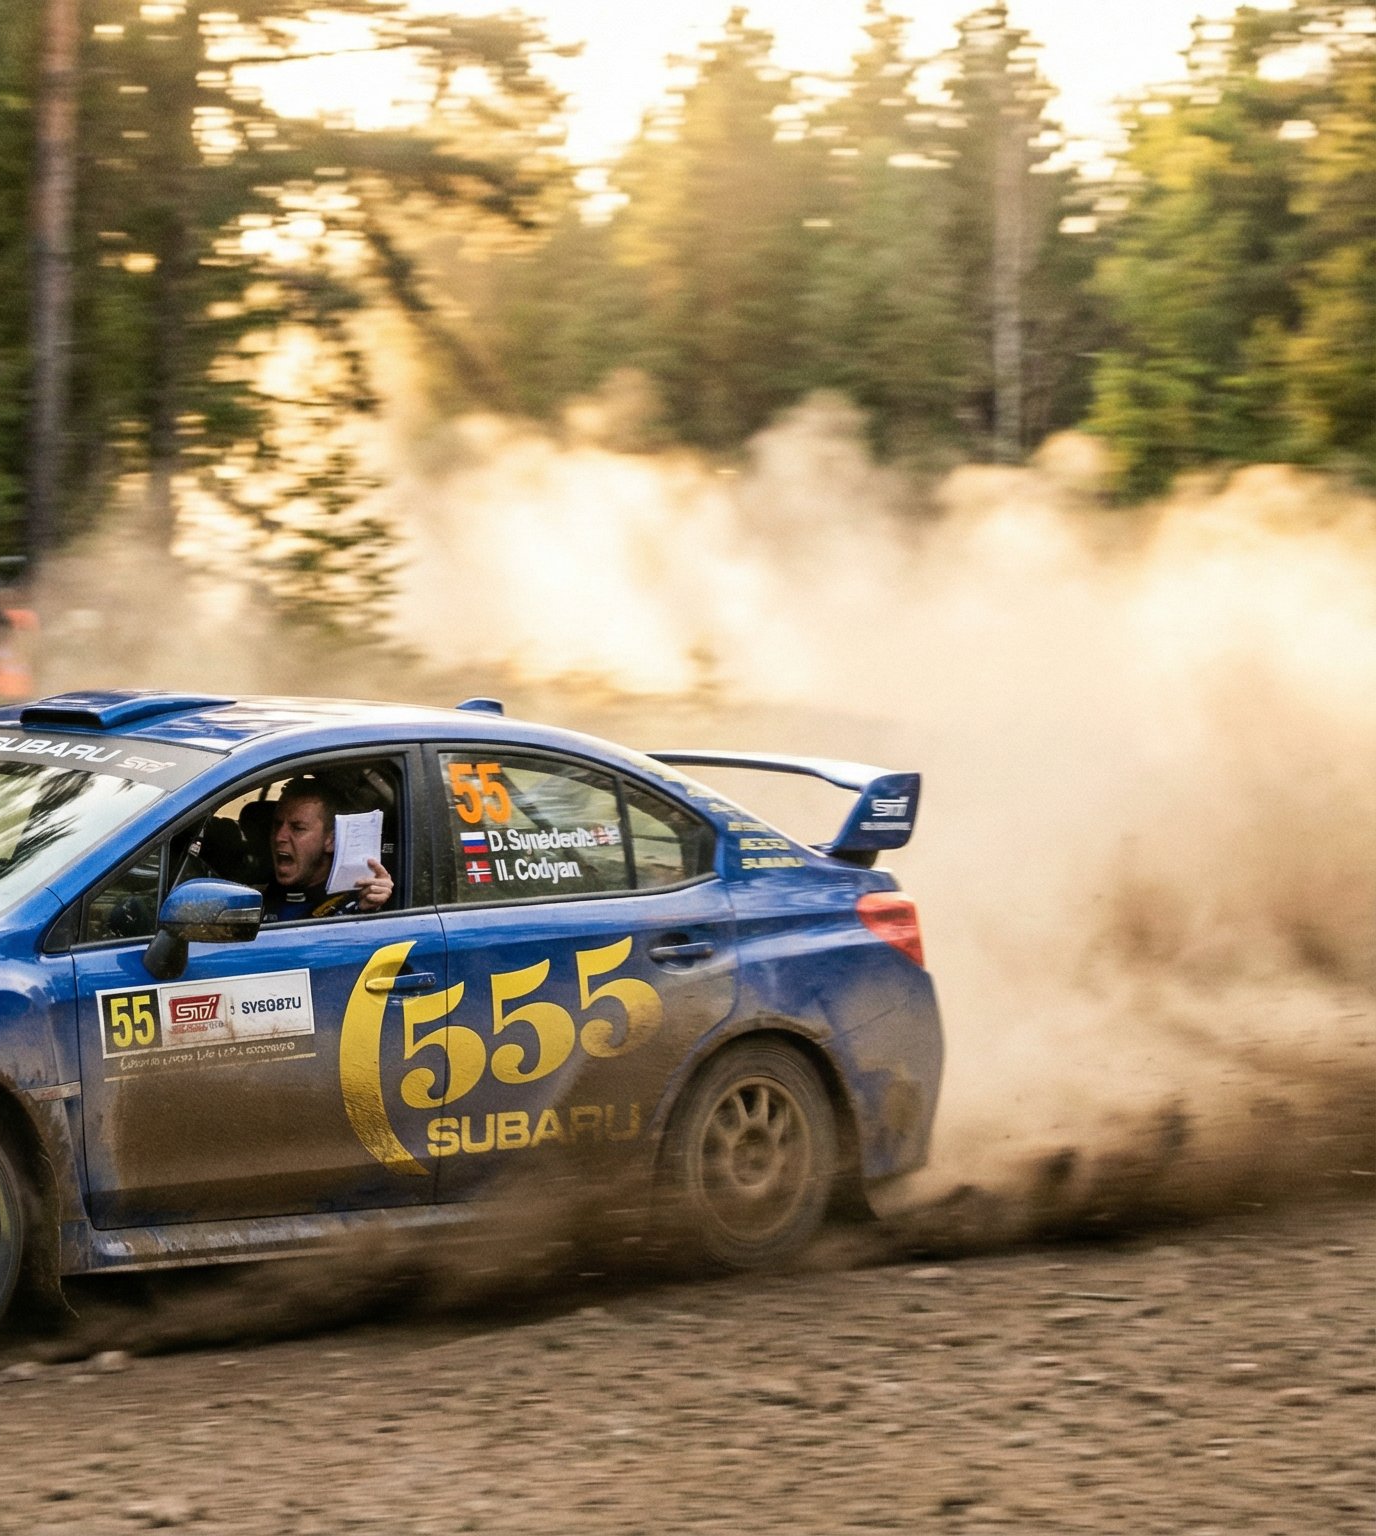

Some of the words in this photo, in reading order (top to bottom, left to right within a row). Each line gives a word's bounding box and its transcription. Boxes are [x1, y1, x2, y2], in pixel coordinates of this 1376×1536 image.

[448, 762, 512, 824] 55
[515, 857, 581, 884] Codyan
[110, 994, 155, 1048] 55
[427, 1102, 641, 1157] SUBARU
